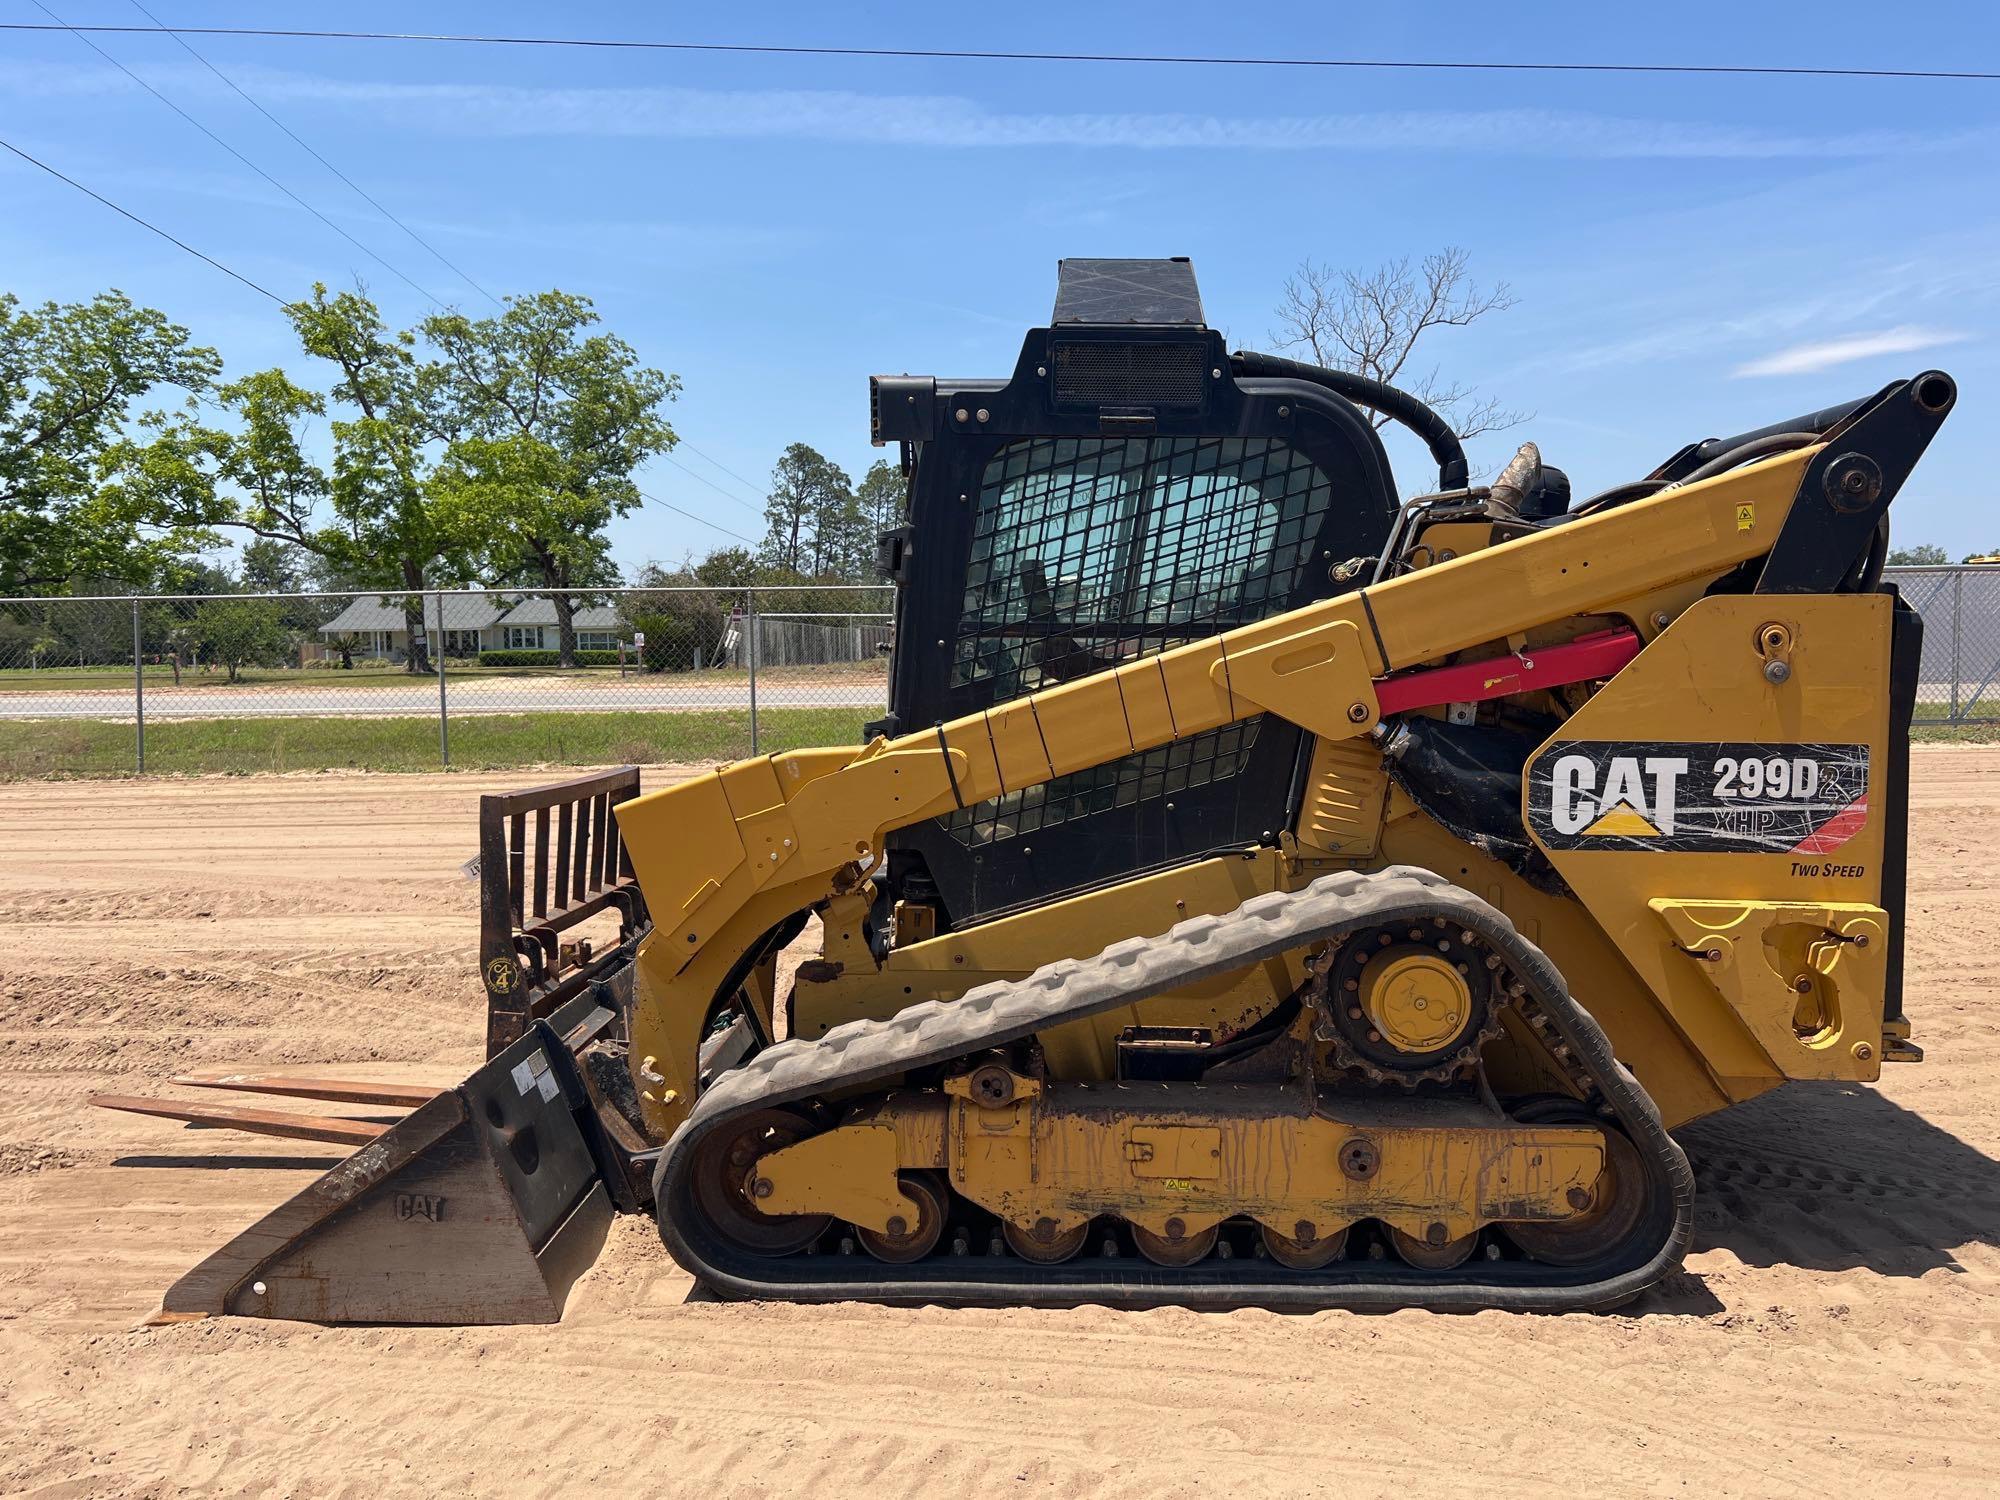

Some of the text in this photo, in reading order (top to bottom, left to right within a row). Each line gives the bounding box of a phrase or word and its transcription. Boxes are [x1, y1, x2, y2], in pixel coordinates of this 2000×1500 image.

[1551, 755, 1688, 836] CAT
[1711, 808, 1776, 837] XHP
[396, 1194, 441, 1222] CAT
